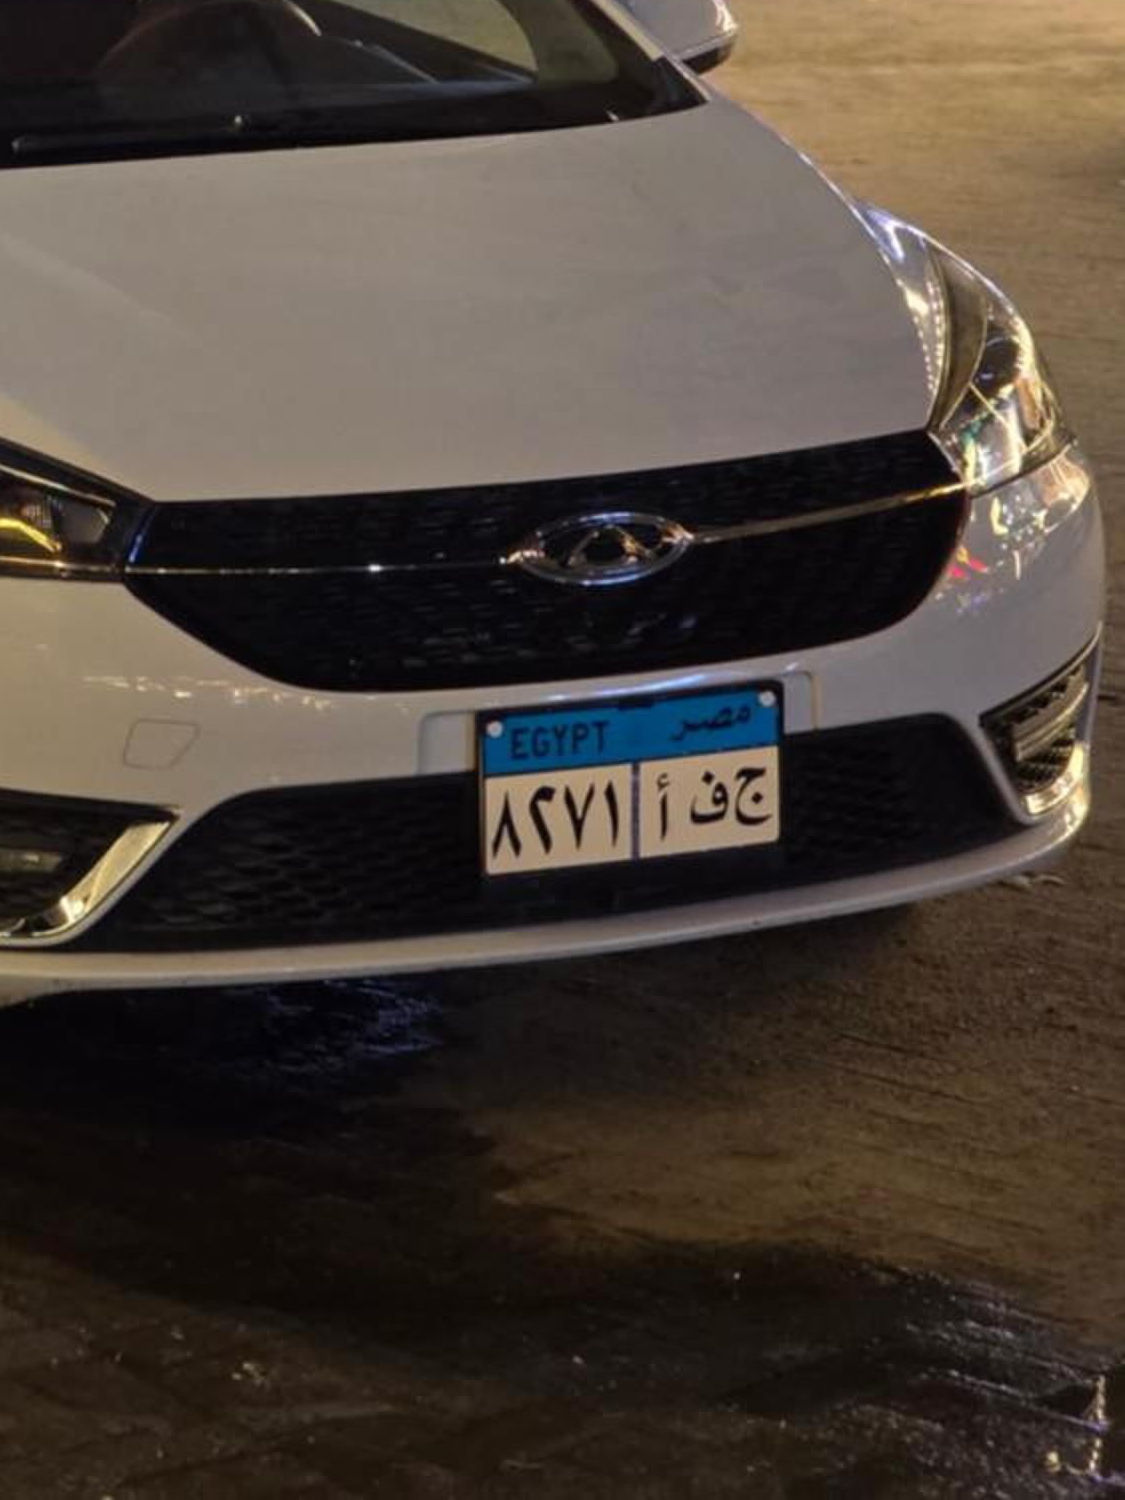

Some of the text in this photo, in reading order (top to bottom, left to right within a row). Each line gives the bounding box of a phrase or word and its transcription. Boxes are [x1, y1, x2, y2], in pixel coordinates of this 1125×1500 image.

[510, 719, 611, 761] EGYPT
[670, 702, 753, 742] مصر
[490, 780, 620, 860] ٨٢٧١
